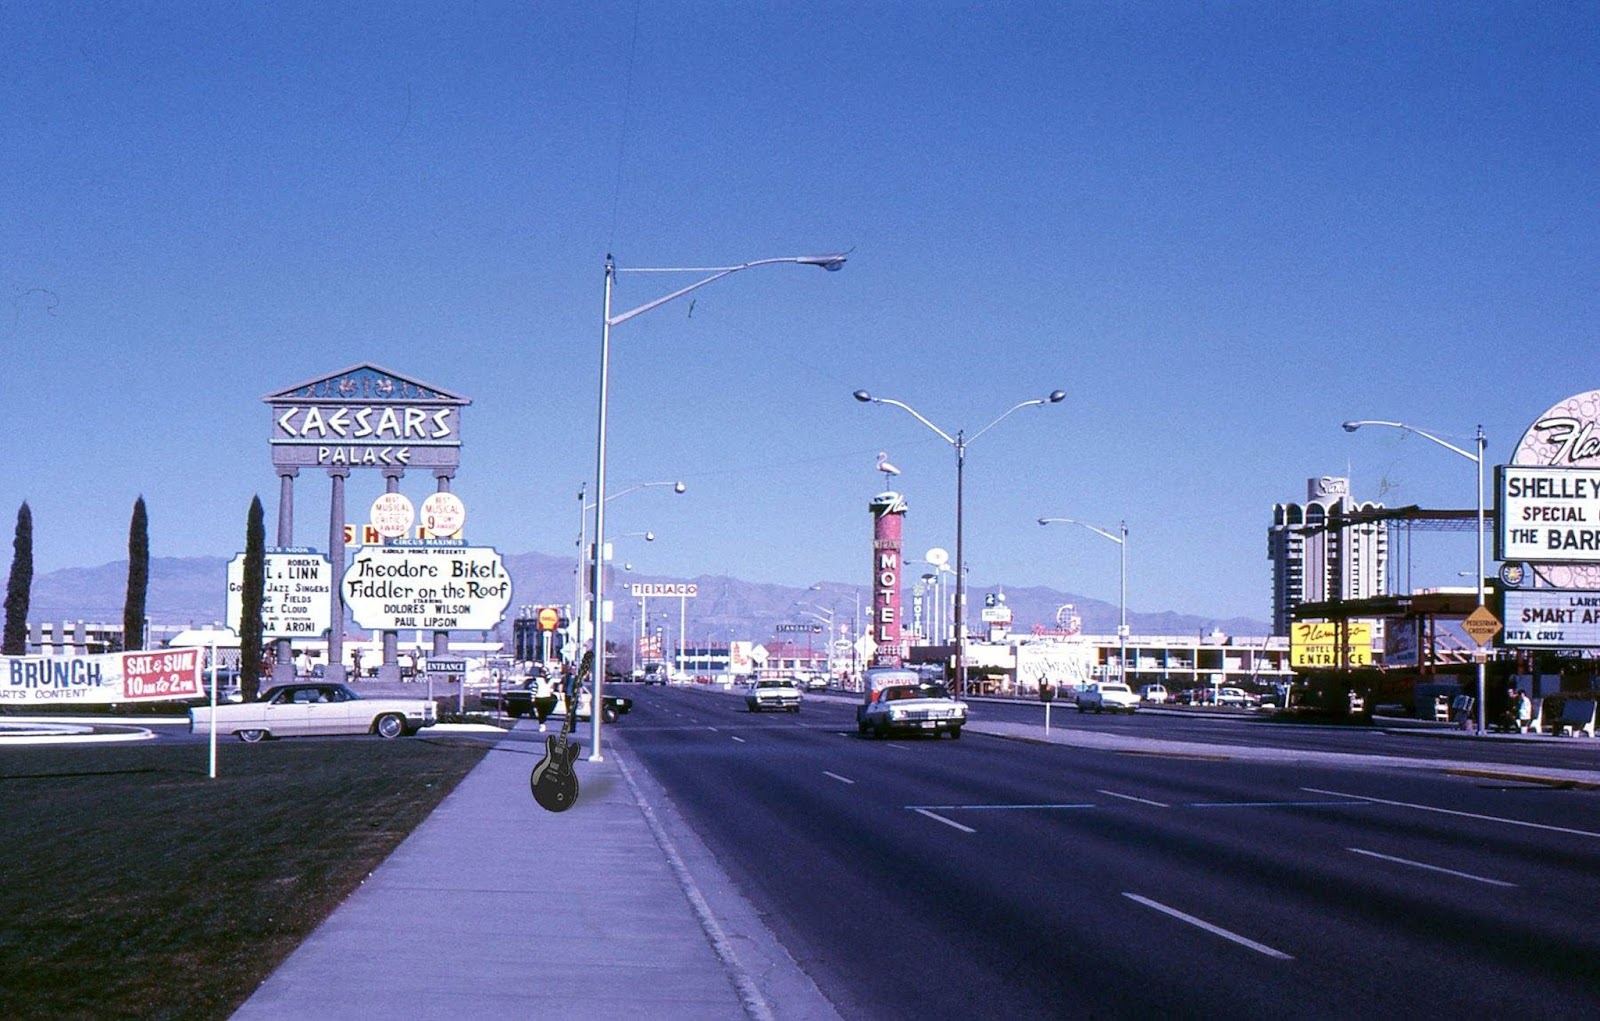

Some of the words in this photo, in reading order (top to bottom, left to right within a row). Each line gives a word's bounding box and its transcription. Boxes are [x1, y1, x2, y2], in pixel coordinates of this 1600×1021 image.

[278, 406, 452, 439] CAESARS
[317, 445, 411, 465] PALACE
[1507, 476, 1600, 499] SHELLEY
[376, 503, 410, 512] MUSICAL
[425, 504, 459, 514] MUSICAL
[1522, 506, 1587, 522] SPECIAL
[427, 515, 436, 530] 9
[1509, 528, 1539, 544] THE
[287, 559, 321, 567] ROBERTA
[357, 557, 438, 578] Theodore
[288, 567, 319, 580] LINN
[266, 583, 289, 593] JAZZ
[295, 583, 330, 593] SINGERS
[347, 579, 413, 598] Fiddler
[418, 587, 437, 598] on
[441, 582, 466, 598] the
[466, 581, 509, 599] Roof
[633, 585, 697, 595] TEXACO
[284, 593, 312, 603] FIELDS
[880, 553, 897, 641] MOTEL
[281, 604, 308, 613] CLOUD
[384, 604, 425, 615] DOLORES
[435, 604, 471, 615] WILSON
[1521, 608, 1576, 624] SMART
[285, 622, 315, 632] ARONI
[394, 617, 416, 627] PAUL
[424, 617, 458, 628] LIPSON
[1468, 627, 1495, 635] CROSSING
[1506, 631, 1532, 640] NITA
[1536, 631, 1564, 641] CRUZ
[1299, 654, 1363, 665] ENTRCE
[153, 659, 162, 674] &
[427, 662, 465, 671] ENTRANCE
[9, 658, 101, 688] BRUNCH
[155, 676, 170, 693] to
[877, 678, 913, 686] U-HAUL
